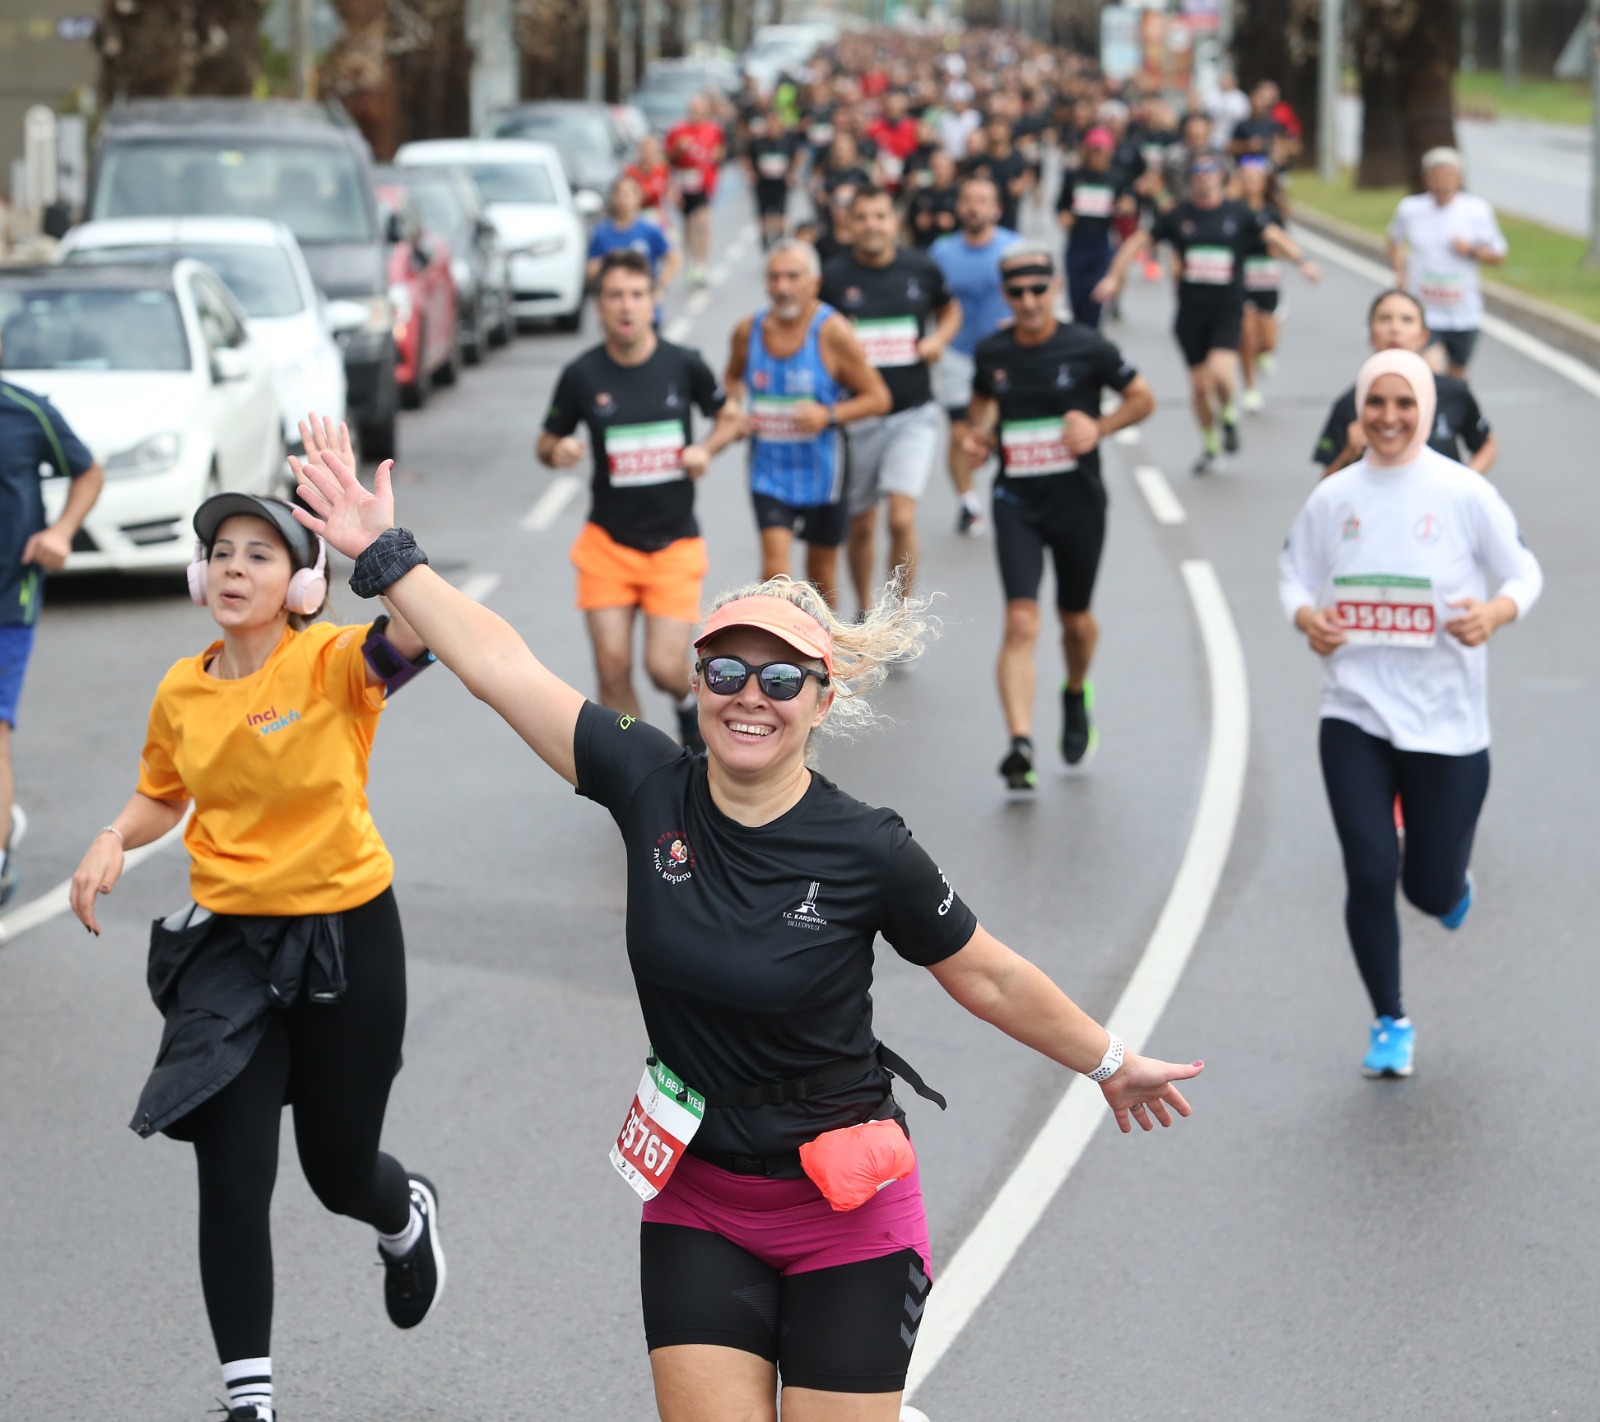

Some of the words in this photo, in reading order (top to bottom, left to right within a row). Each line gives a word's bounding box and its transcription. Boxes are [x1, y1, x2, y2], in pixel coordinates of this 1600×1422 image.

[1339, 604, 1433, 632] 35966
[653, 847, 663, 873] SAYGI
[662, 870, 692, 885] KOŞUSU
